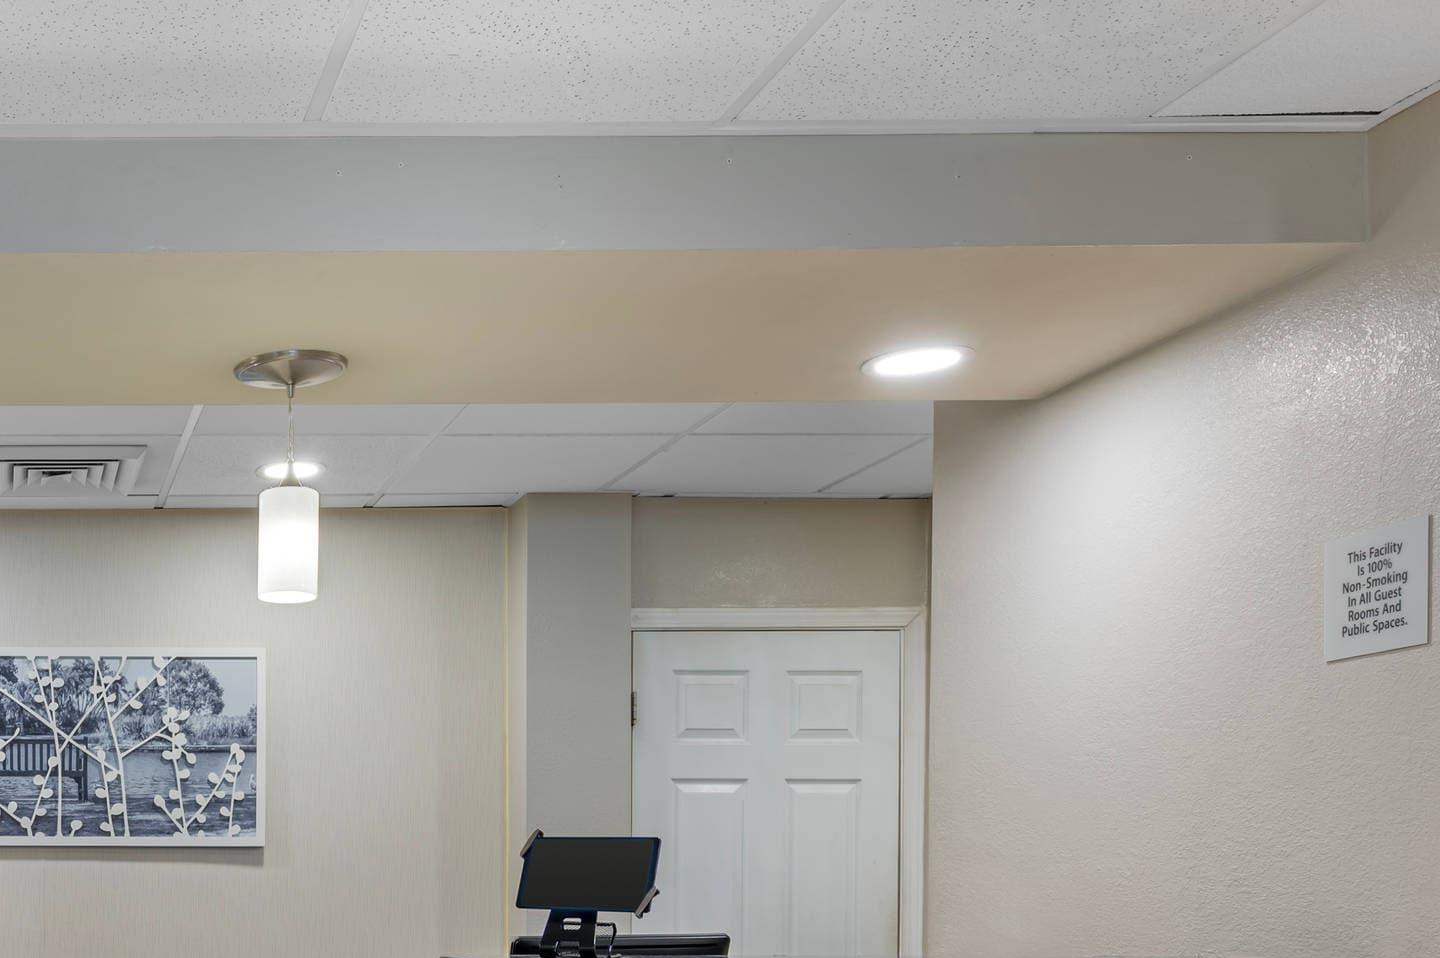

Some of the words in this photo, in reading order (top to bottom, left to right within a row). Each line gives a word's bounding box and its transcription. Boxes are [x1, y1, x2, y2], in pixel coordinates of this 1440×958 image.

[1347, 551, 1366, 564] This
[1369, 541, 1403, 559] Facility
[1357, 564, 1365, 576] Is
[1367, 558, 1393, 574] 100%
[1342, 570, 1408, 594] Non-Smoking
[1347, 596, 1357, 607] In
[1359, 591, 1371, 605] All
[1374, 586, 1402, 602] Guest
[1347, 607, 1379, 622] Rooms
[1382, 600, 1402, 615] And
[1342, 623, 1370, 638] Public
[1372, 616, 1408, 634] Spaces.
